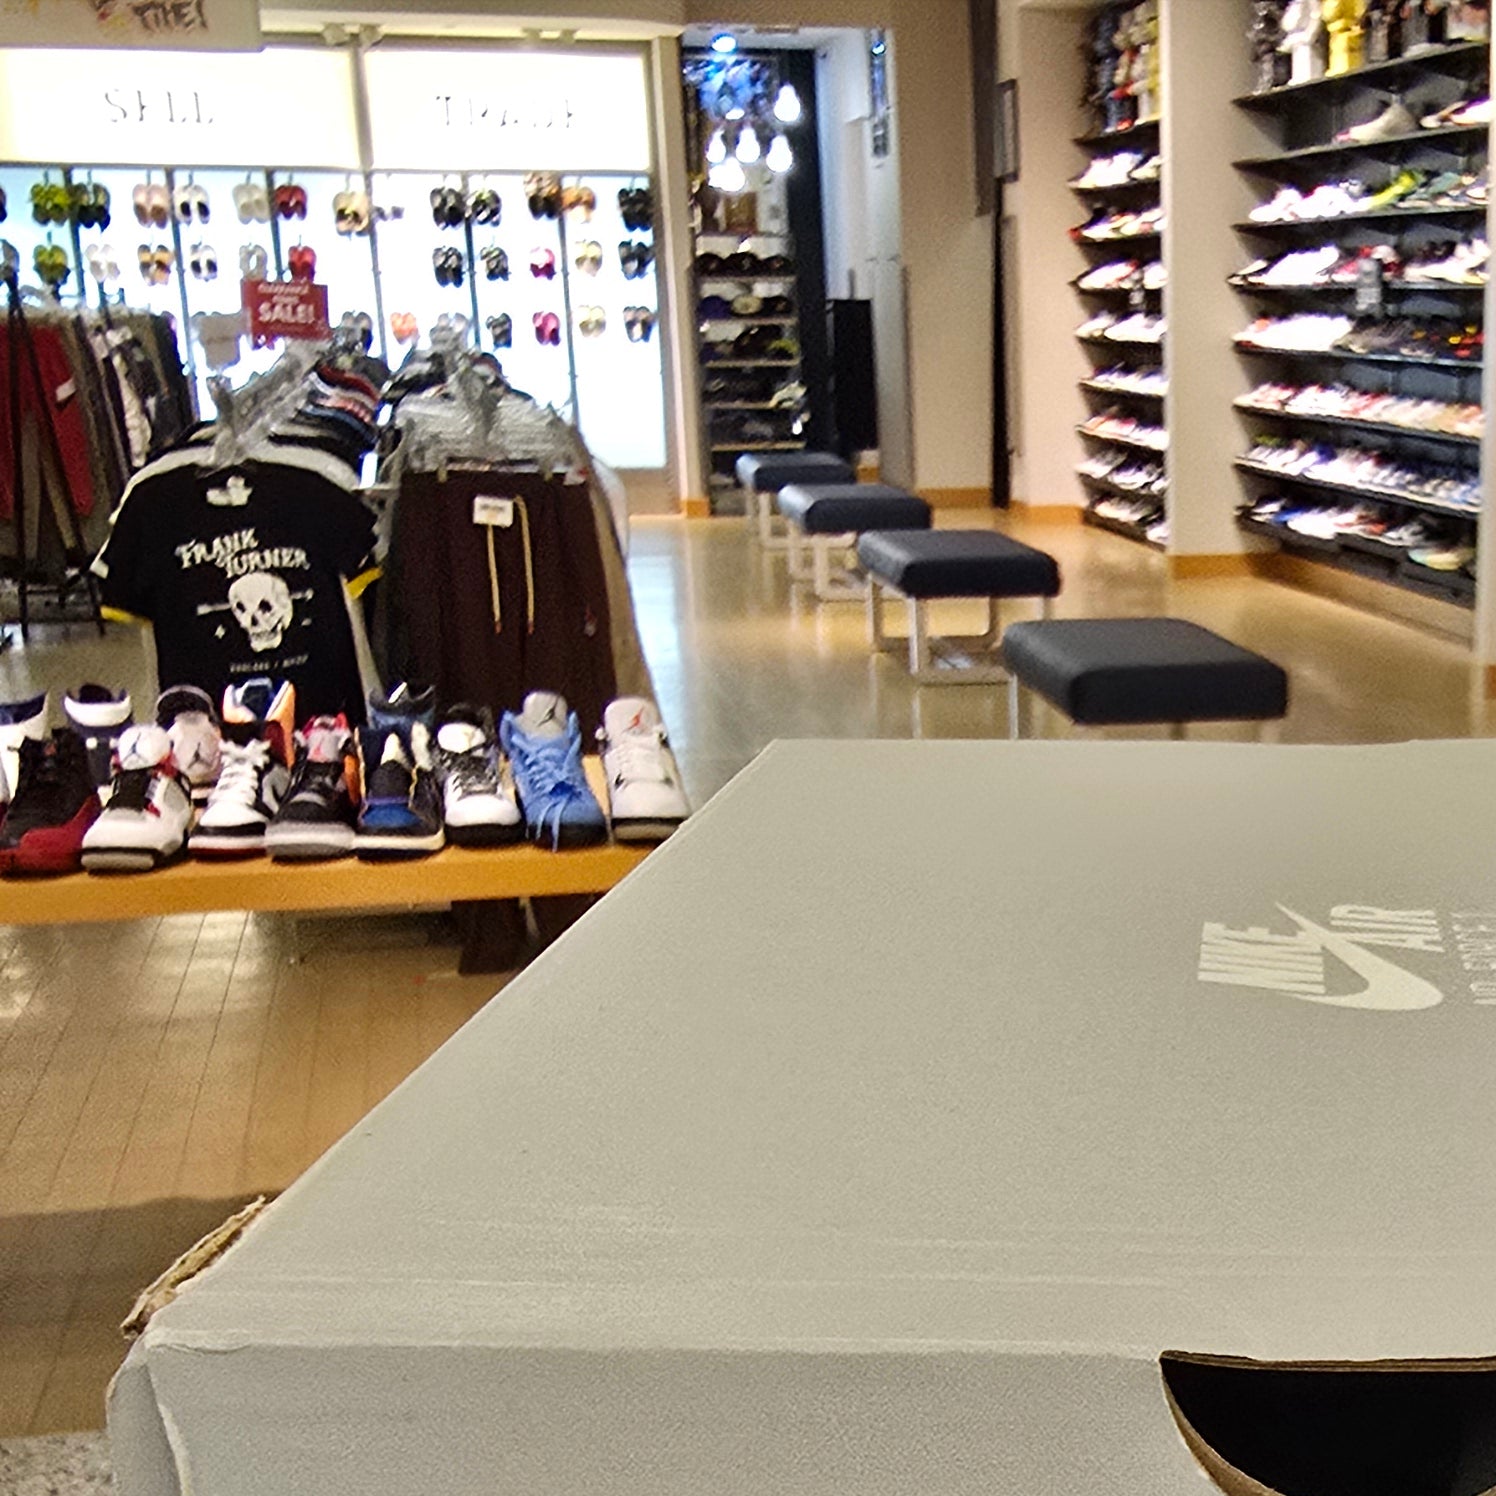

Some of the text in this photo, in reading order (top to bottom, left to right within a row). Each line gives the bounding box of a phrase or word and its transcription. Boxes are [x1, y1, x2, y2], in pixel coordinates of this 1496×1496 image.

[175, 527, 259, 569] FRANK
[216, 547, 311, 578] TURNER
[1330, 904, 1446, 953] AIR
[1197, 921, 1326, 994] NIKE
